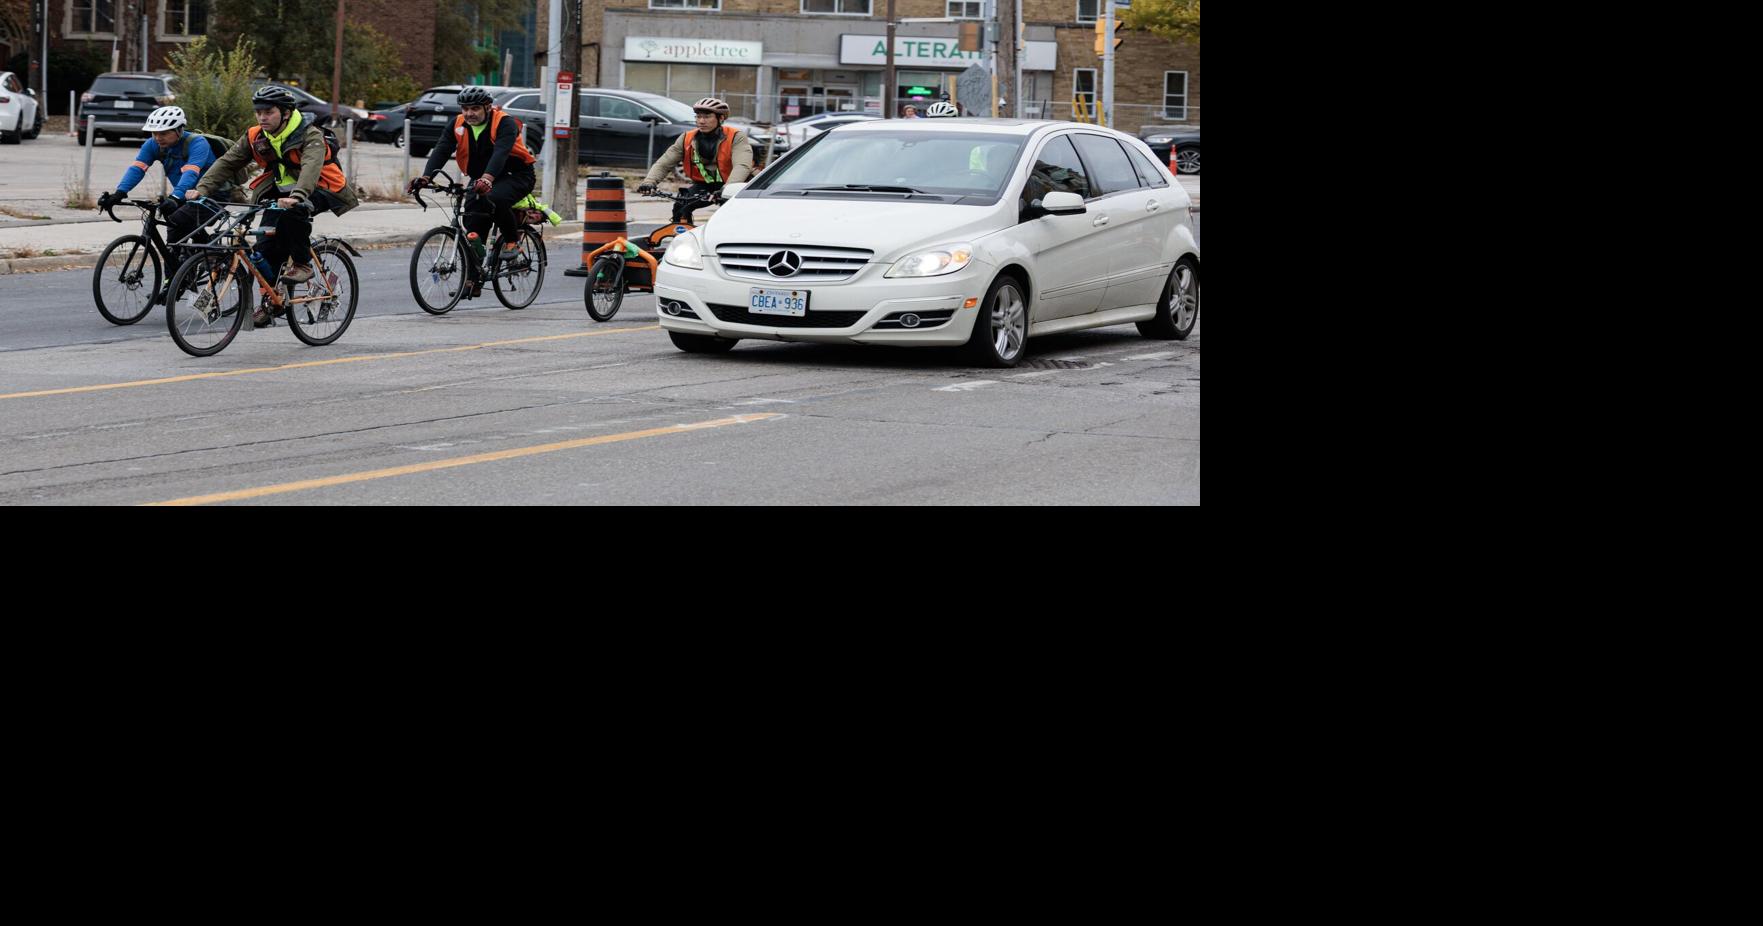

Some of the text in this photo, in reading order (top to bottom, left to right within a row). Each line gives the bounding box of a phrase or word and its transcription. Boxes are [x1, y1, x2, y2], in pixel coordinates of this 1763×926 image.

[663, 42, 749, 58] appletree
[872, 40, 982, 59] ATERA
[752, 295, 804, 310] CBEA 936
